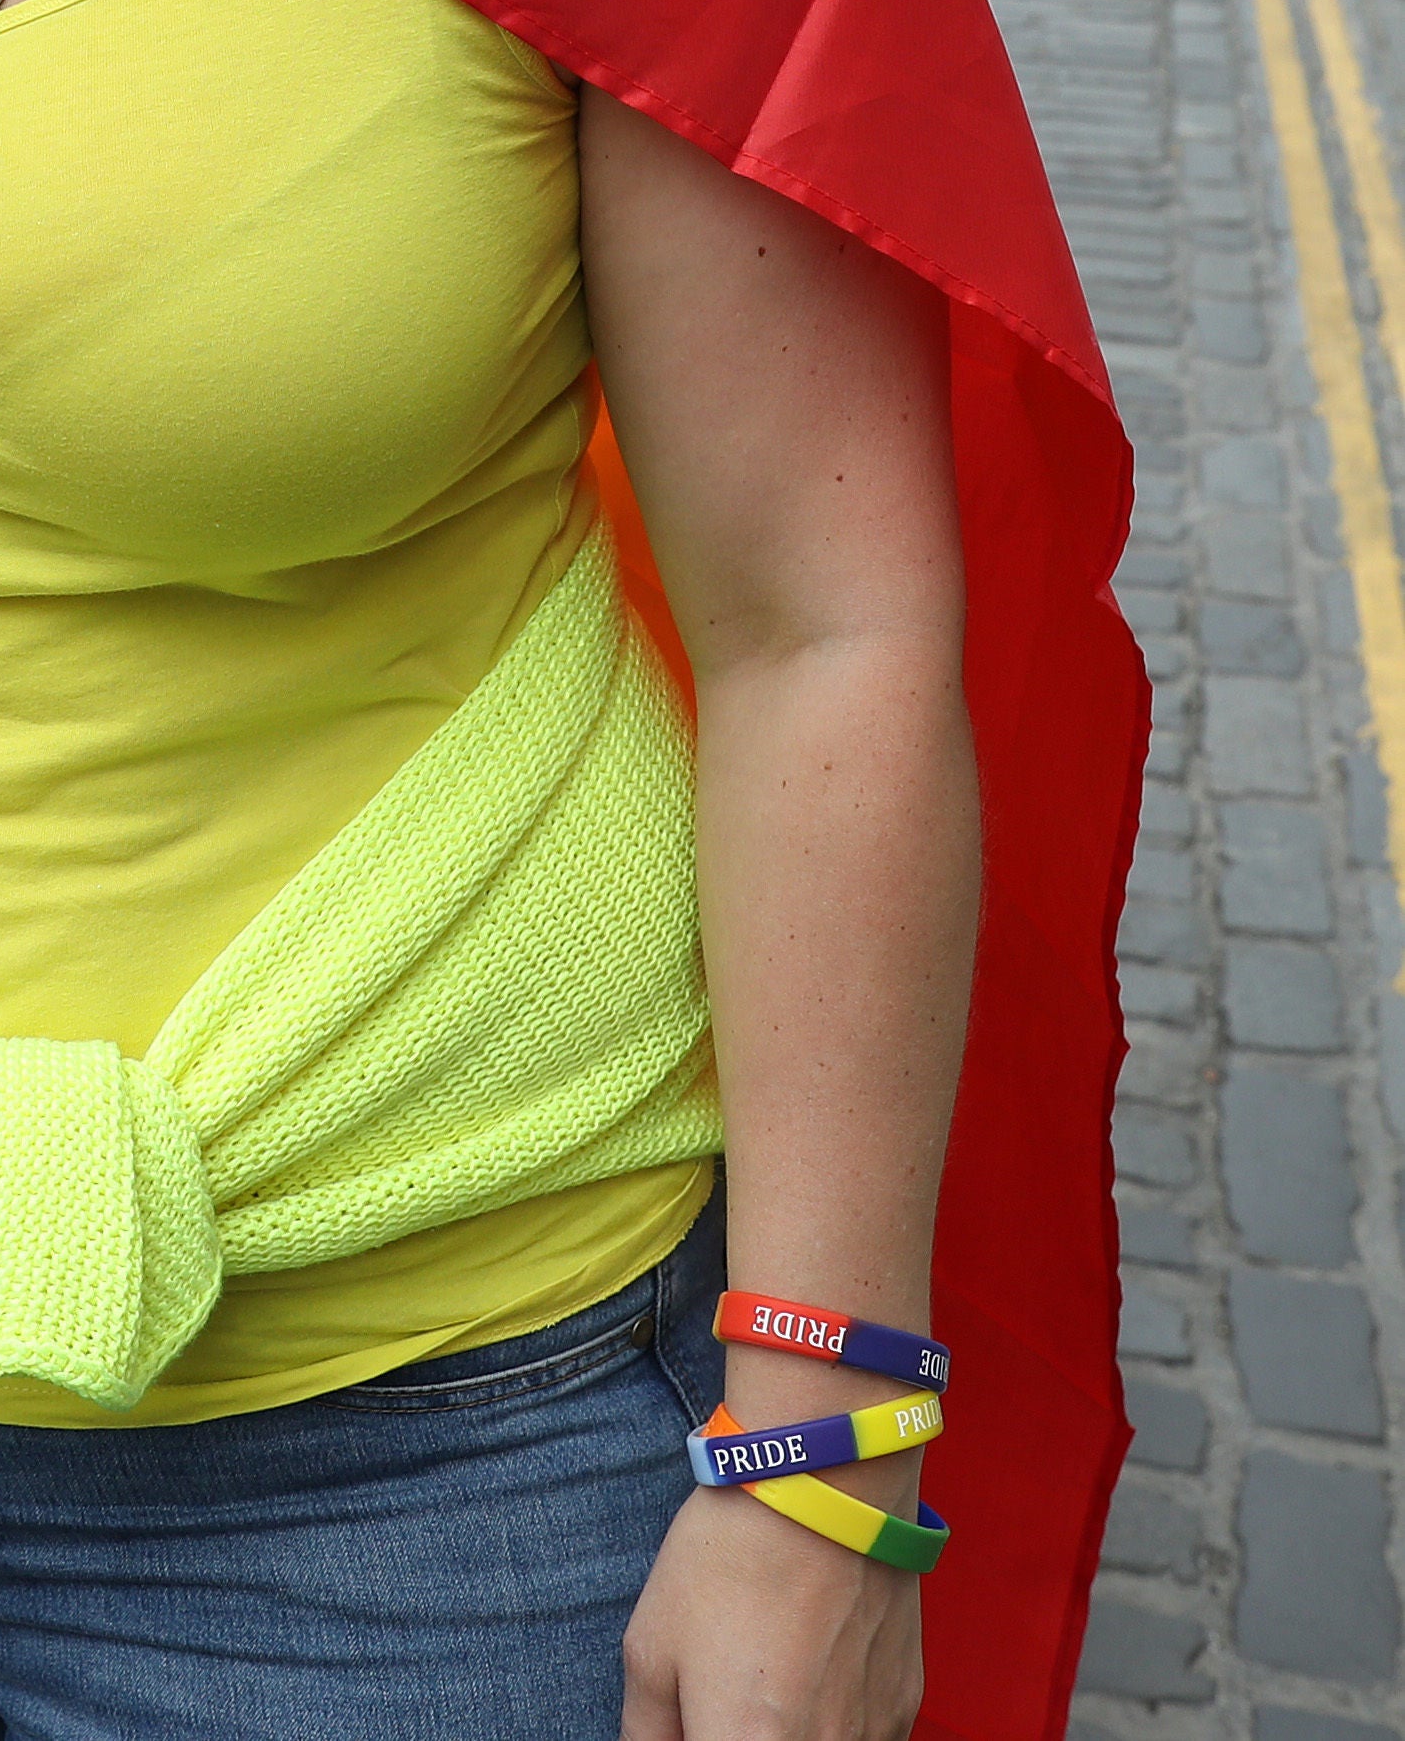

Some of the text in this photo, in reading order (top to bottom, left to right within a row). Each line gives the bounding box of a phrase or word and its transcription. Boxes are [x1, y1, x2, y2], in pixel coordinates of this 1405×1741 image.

[752, 1306, 846, 1354] PRIDE
[713, 1398, 943, 1476] PRIDE PRID
